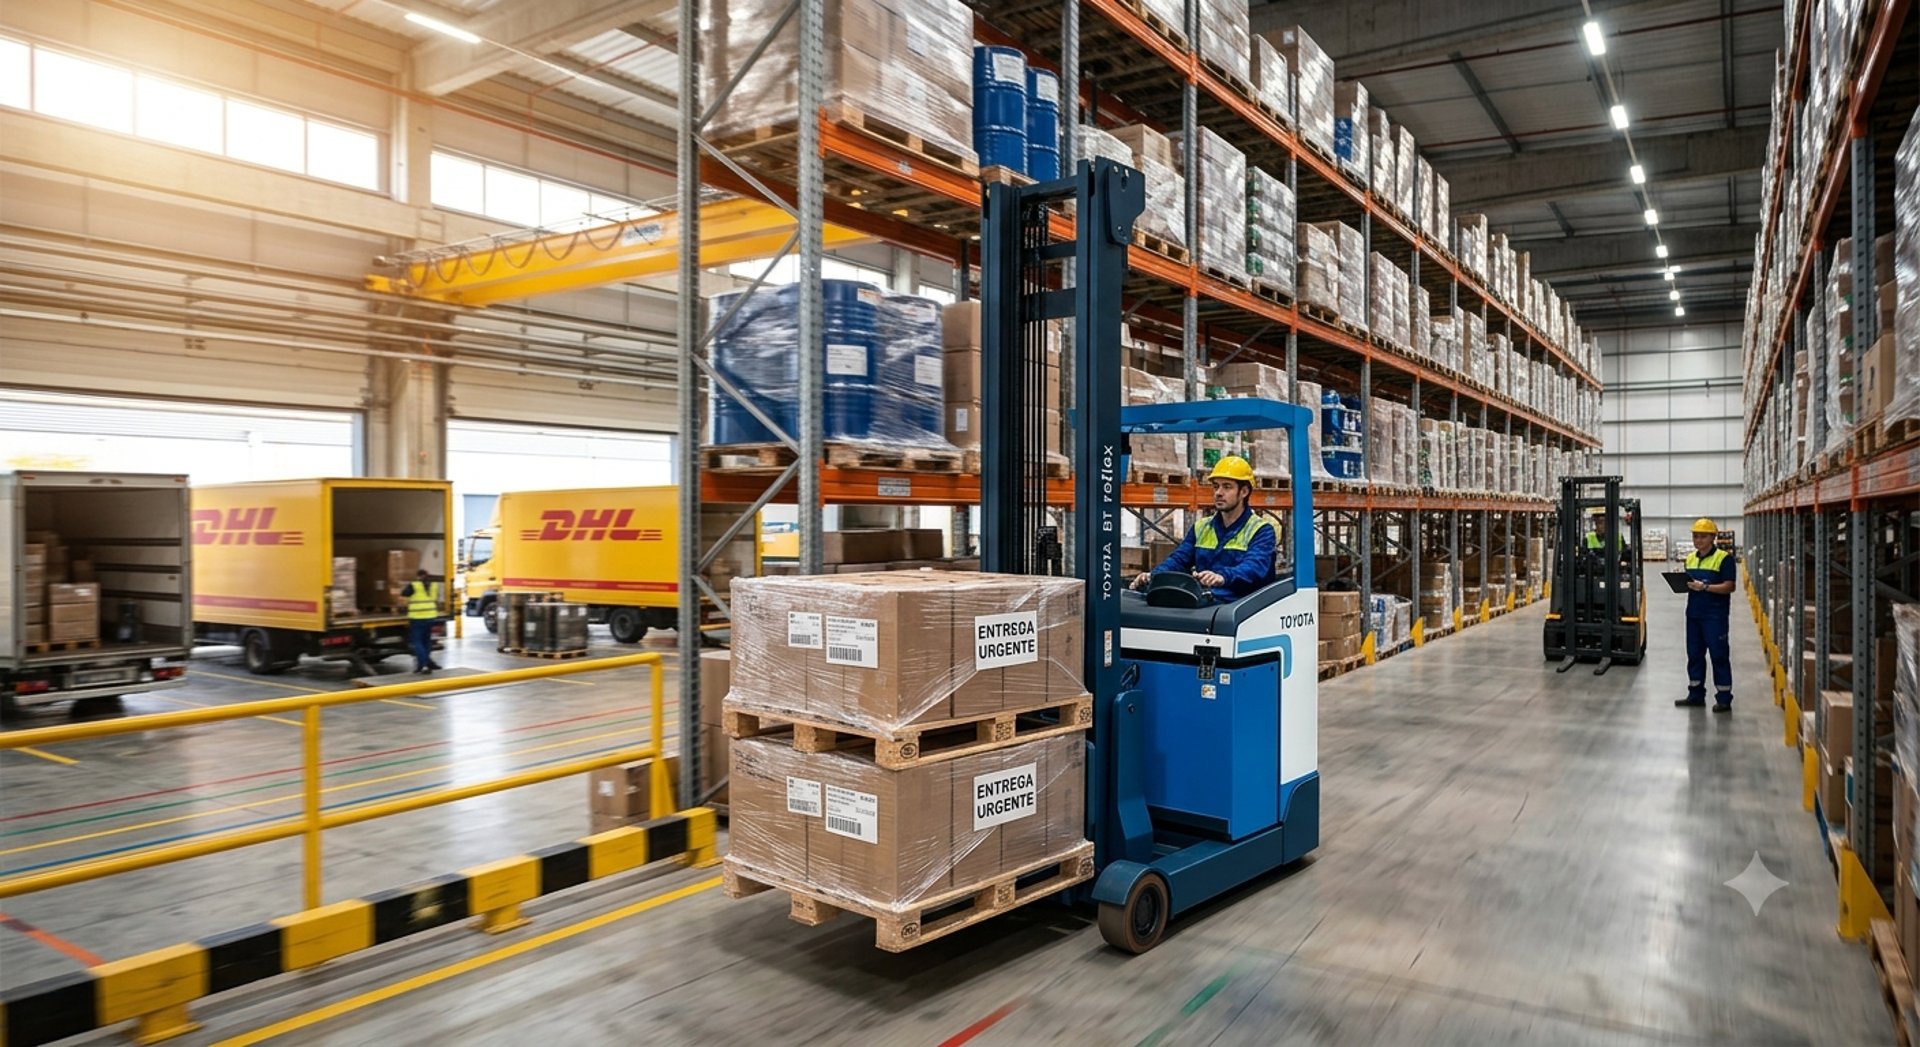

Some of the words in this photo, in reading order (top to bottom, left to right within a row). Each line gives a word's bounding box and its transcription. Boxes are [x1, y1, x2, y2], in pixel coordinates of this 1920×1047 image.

[192, 507, 283, 545] DHL
[539, 508, 643, 541] DHL
[1103, 511, 1112, 531] BT
[1280, 612, 1314, 629] TOYOTA
[978, 639, 1035, 659] URGENTE
[977, 773, 1034, 799] ENTREGA
[977, 791, 1034, 819] URGENTE
